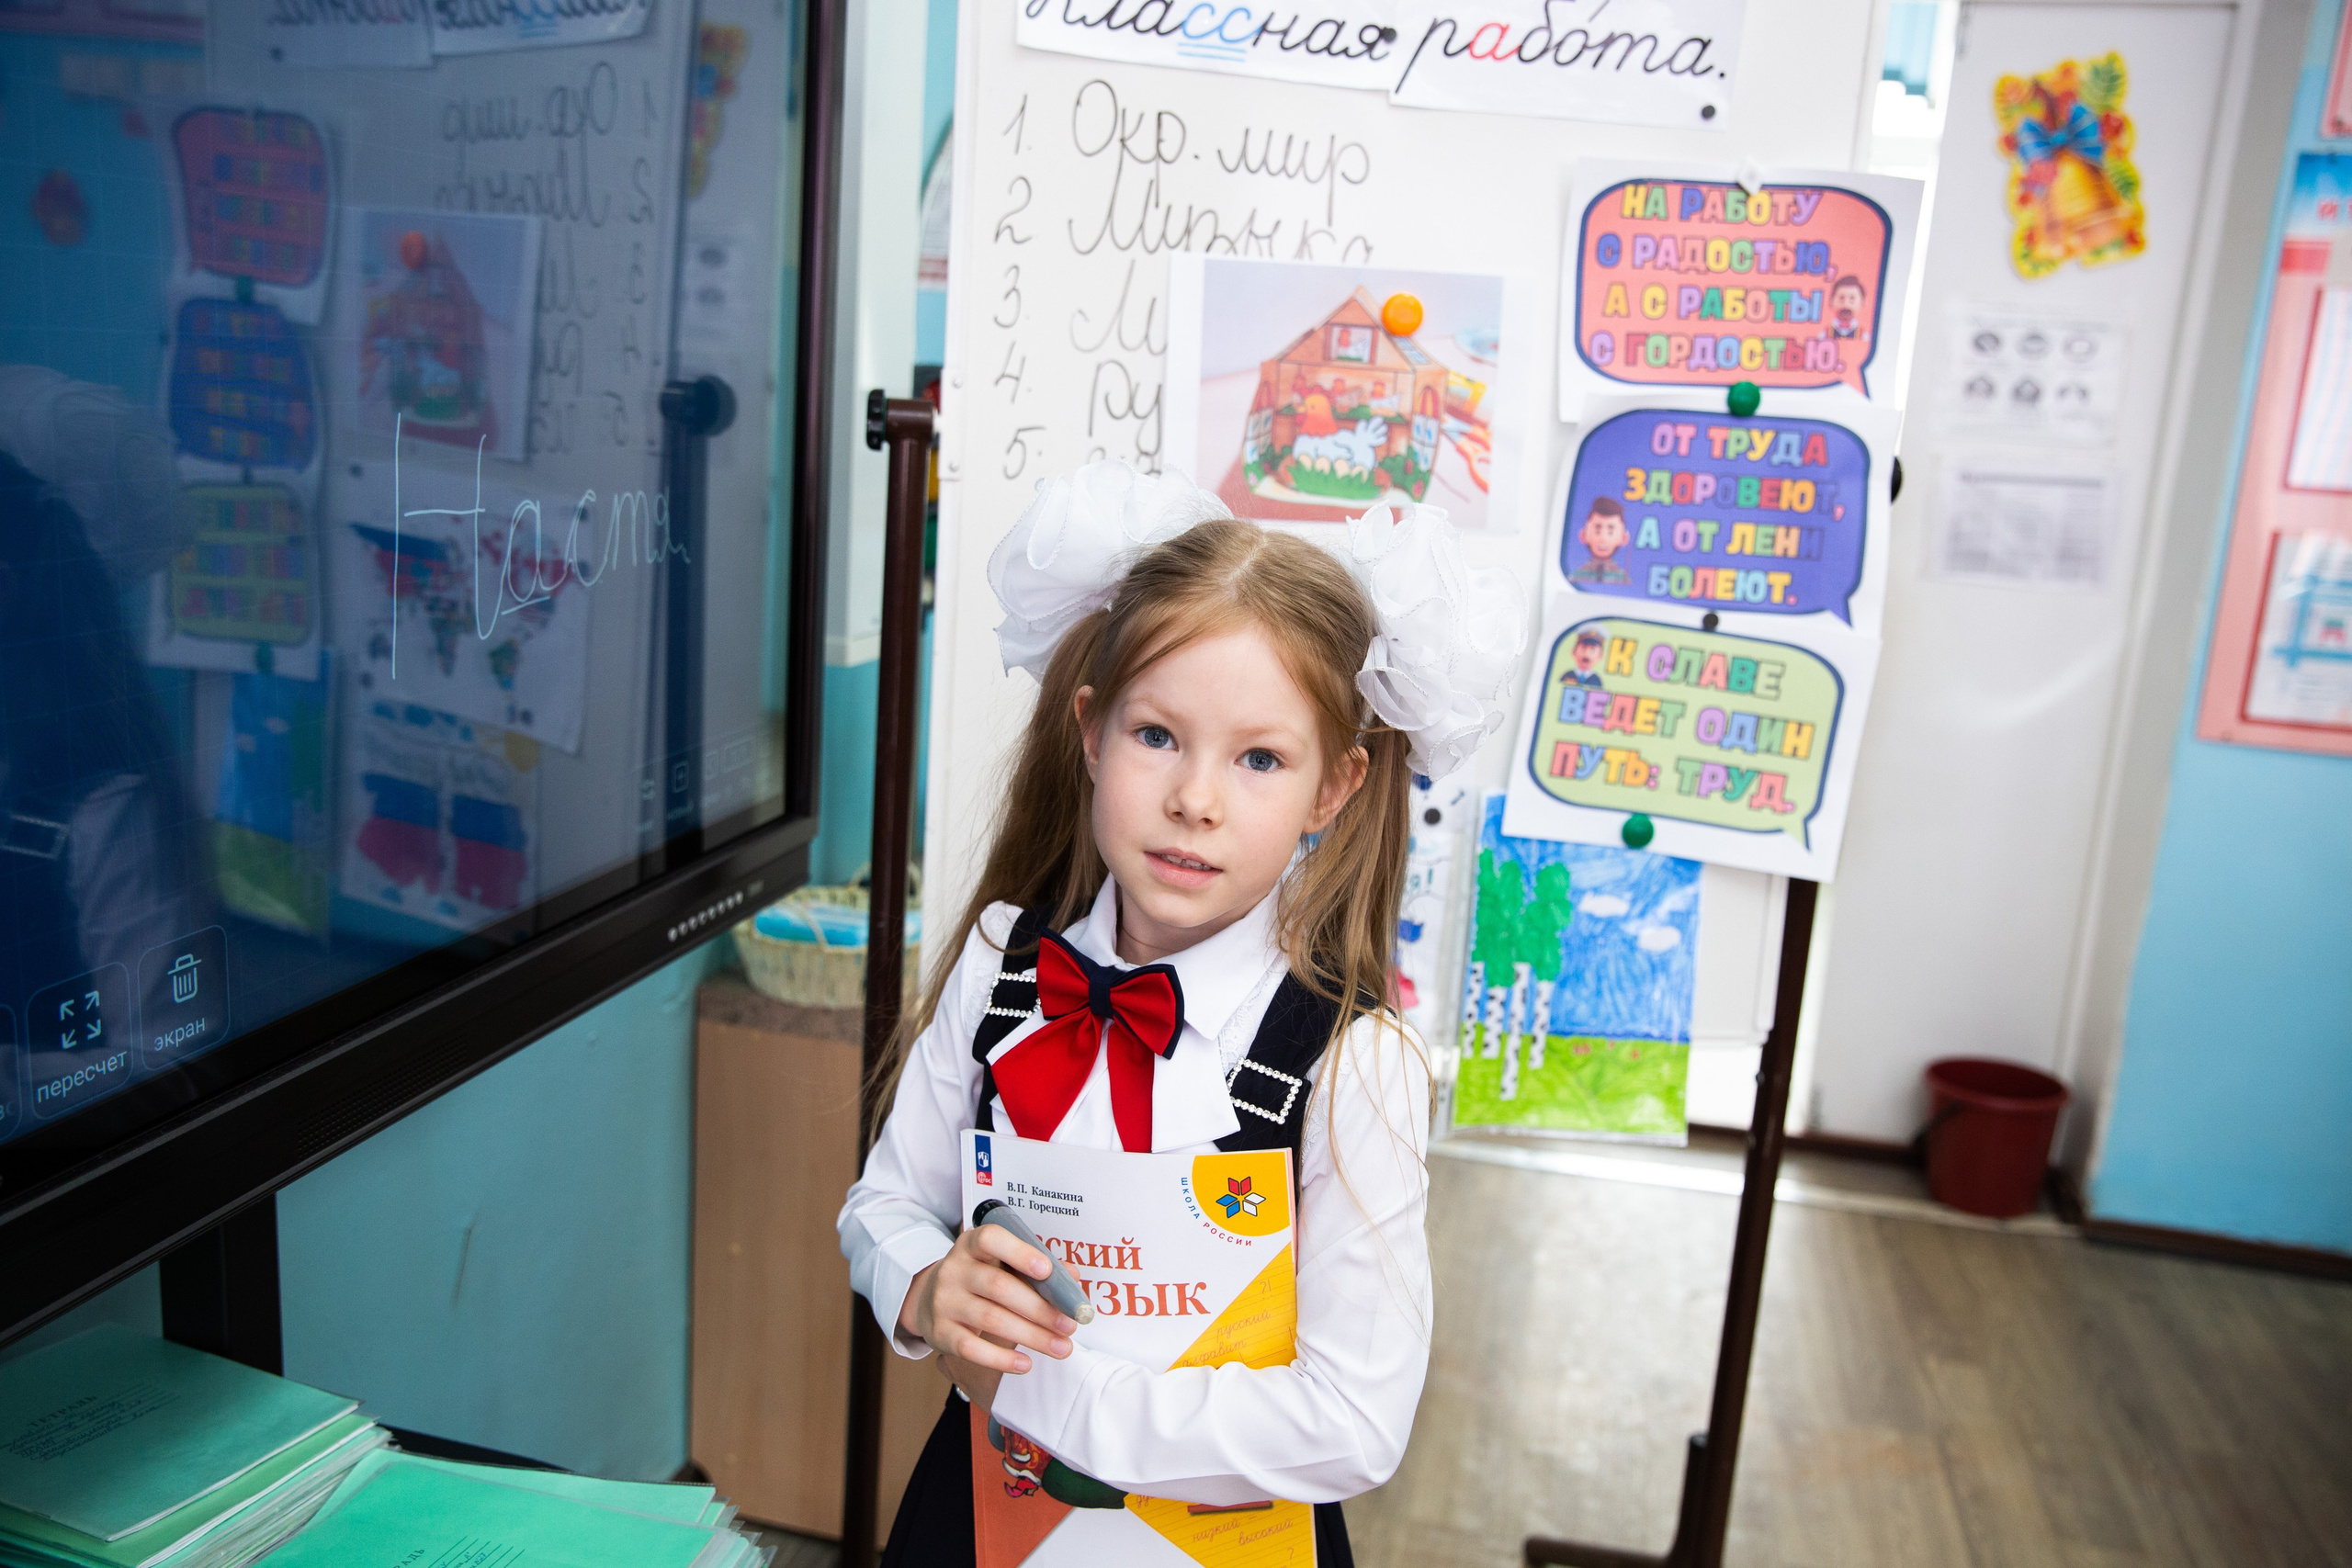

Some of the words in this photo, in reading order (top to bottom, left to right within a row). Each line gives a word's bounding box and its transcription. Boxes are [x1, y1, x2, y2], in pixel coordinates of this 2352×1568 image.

[1025, 0, 1389, 61] лассная
[1216, 127, 1370, 227] мир
[1621, 184, 1668, 221] НА
[1680, 186, 1823, 226] РАБОТУ
[1597, 233, 1621, 268] С
[1632, 234, 1838, 282] РАДОСТЬЮ,
[1602, 282, 1630, 319] А
[1641, 283, 1668, 320] С
[1678, 285, 1824, 323] РАБОТЫ
[1589, 330, 1615, 367] С
[1624, 333, 1847, 373] ГОРДОСТЬЮ.
[1651, 423, 1697, 457] ОТ
[1706, 425, 1828, 467] ТРУДА
[1623, 467, 1845, 521] ЗДОРОВЕЮТ,
[1635, 517, 1661, 550] А
[1671, 519, 1719, 553] ОТ
[1726, 521, 1825, 562] ЛЕНИ
[1646, 565, 1798, 606] БОЛЕЮТ.
[1606, 637, 1637, 677] К
[1645, 643, 1786, 701] СЛАВЕ
[1557, 686, 1686, 738] ВЕДЕТ
[1696, 706, 1815, 761] ОДИН
[1549, 740, 1661, 791] ПУТЬ:
[1676, 757, 1796, 815] ТРУД.
[153, 1017, 207, 1052] экран
[37, 1051, 128, 1103] пересчет
[1028, 1200, 1080, 1217] Горецкий
[1032, 1186, 1084, 1203] Канакина
[1181, 1177, 1201, 1219] ШКОЛА
[1203, 1222, 1252, 1247] РОССИИ
[1216, 1309, 1272, 1343] русский
[1193, 1517, 1240, 1543] низкий
[1238, 1518, 1293, 1546] высокий
